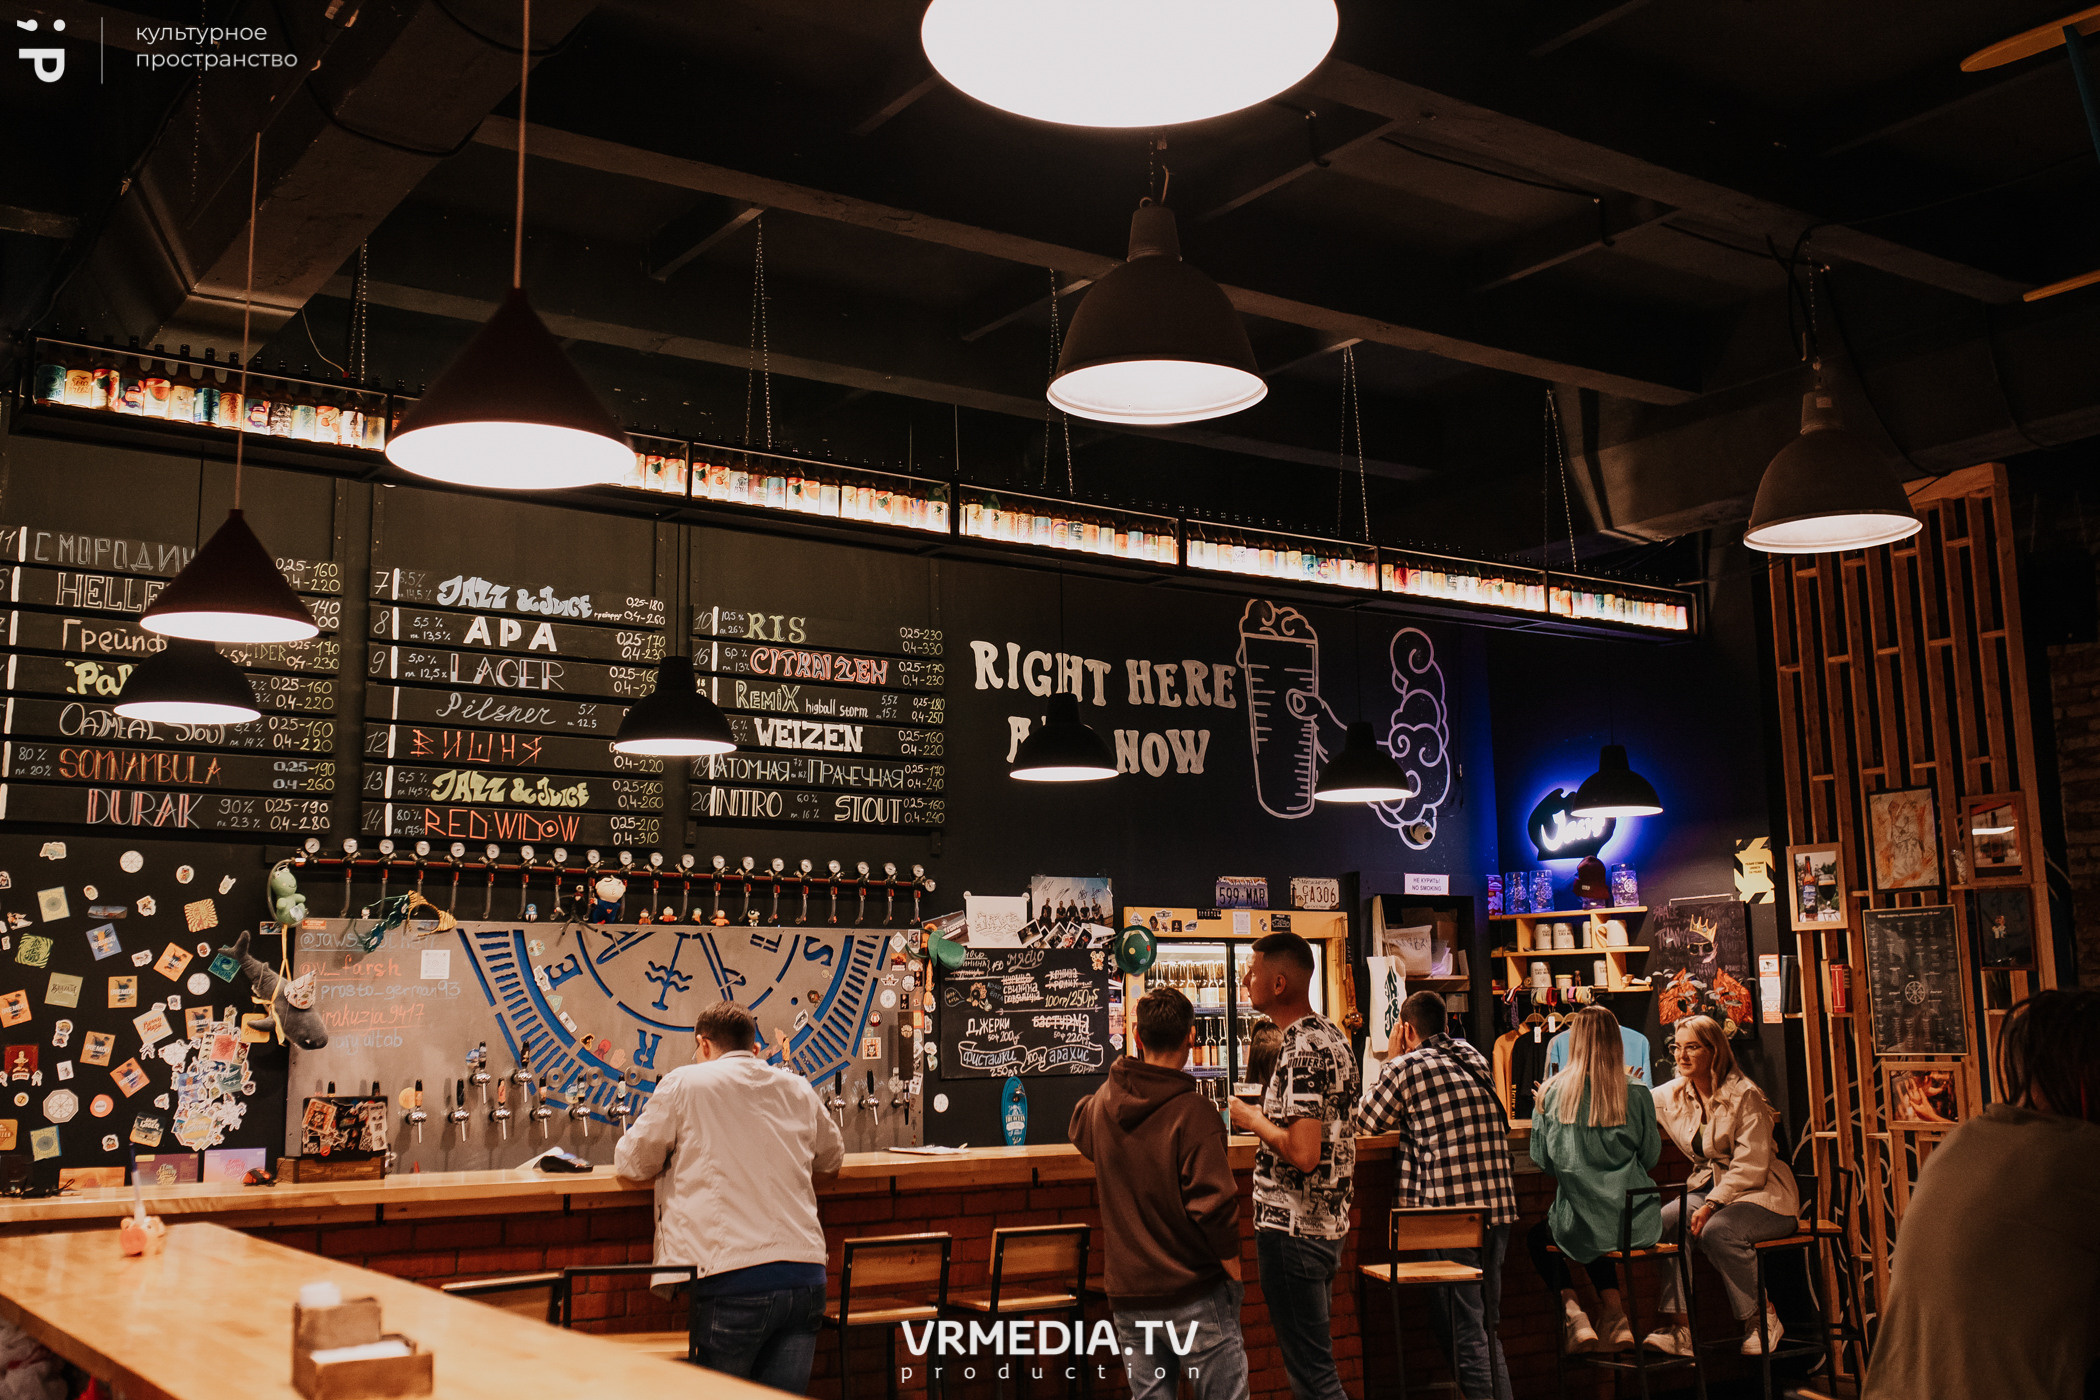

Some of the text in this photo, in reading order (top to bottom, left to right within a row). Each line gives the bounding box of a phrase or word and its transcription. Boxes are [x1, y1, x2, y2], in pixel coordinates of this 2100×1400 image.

[56, 571, 172, 613] HELLE
[374, 571, 389, 594] 7
[437, 575, 511, 609] JAZZ
[374, 610, 389, 634] 8
[463, 615, 558, 652] APA
[694, 611, 712, 631] 10
[742, 611, 807, 644] RIS
[369, 651, 386, 674] 9
[450, 653, 565, 691] LAGER
[692, 648, 710, 667] 16
[970, 640, 1237, 709] RIGHT HERE
[436, 691, 557, 725] Pilsner
[365, 731, 389, 753] 12
[410, 729, 543, 767] ВИШНЯ
[753, 717, 864, 754] WEIZEN
[59, 748, 222, 786] SOMNAMBULA
[1113, 728, 1211, 778] NOW
[363, 770, 384, 791] 13
[430, 769, 507, 803] JAZZ
[713, 753, 791, 782] АТОМНАЯ
[807, 759, 904, 790] ПРАЧЕЧНАЯ
[86, 788, 204, 830] DURAK
[361, 808, 385, 831] 14
[691, 791, 711, 812] 20
[834, 796, 903, 824] STOUT
